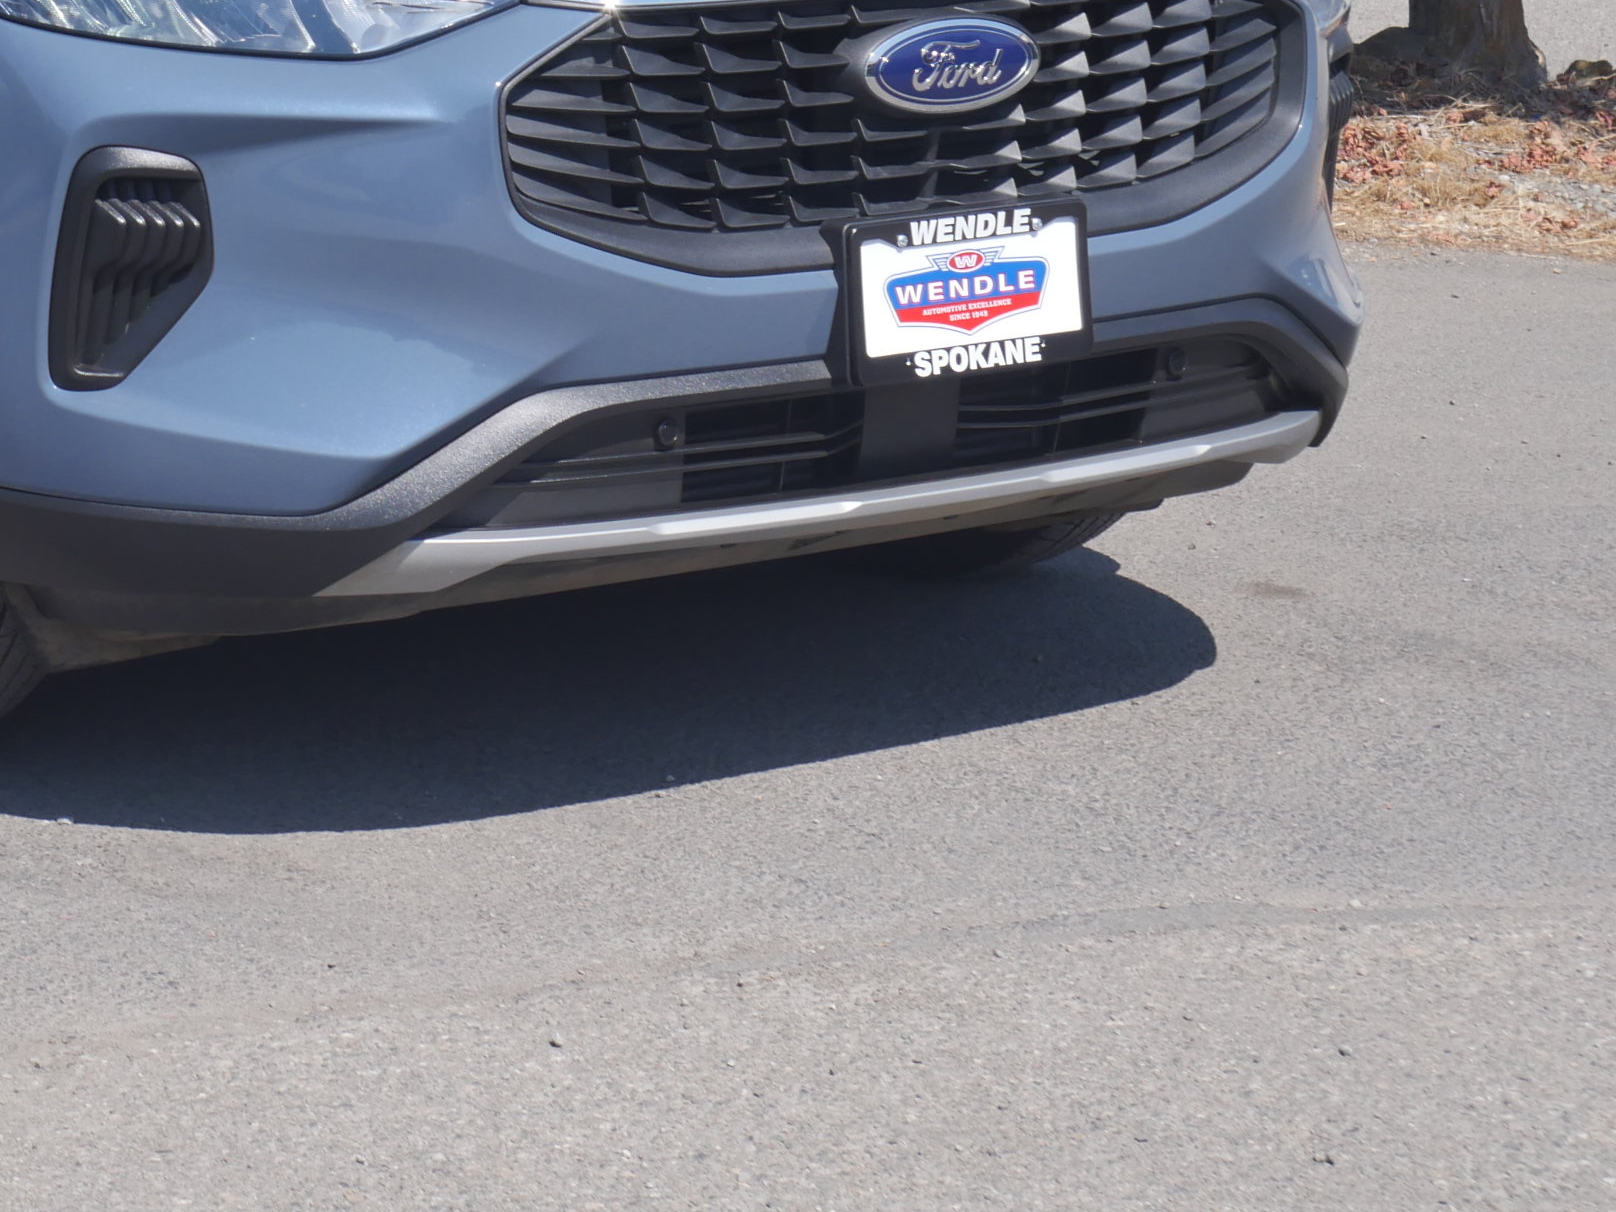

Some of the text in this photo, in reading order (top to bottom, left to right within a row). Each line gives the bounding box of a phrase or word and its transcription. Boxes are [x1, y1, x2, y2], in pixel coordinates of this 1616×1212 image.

[912, 39, 1004, 92] Ford
[910, 208, 1032, 246] WENDLE
[895, 269, 1036, 305] WENDLE
[922, 298, 1012, 316] AUTOMOTIVE EXCELLENCE
[949, 312, 971, 321] SINCE
[914, 336, 1042, 378] SPOKANE
